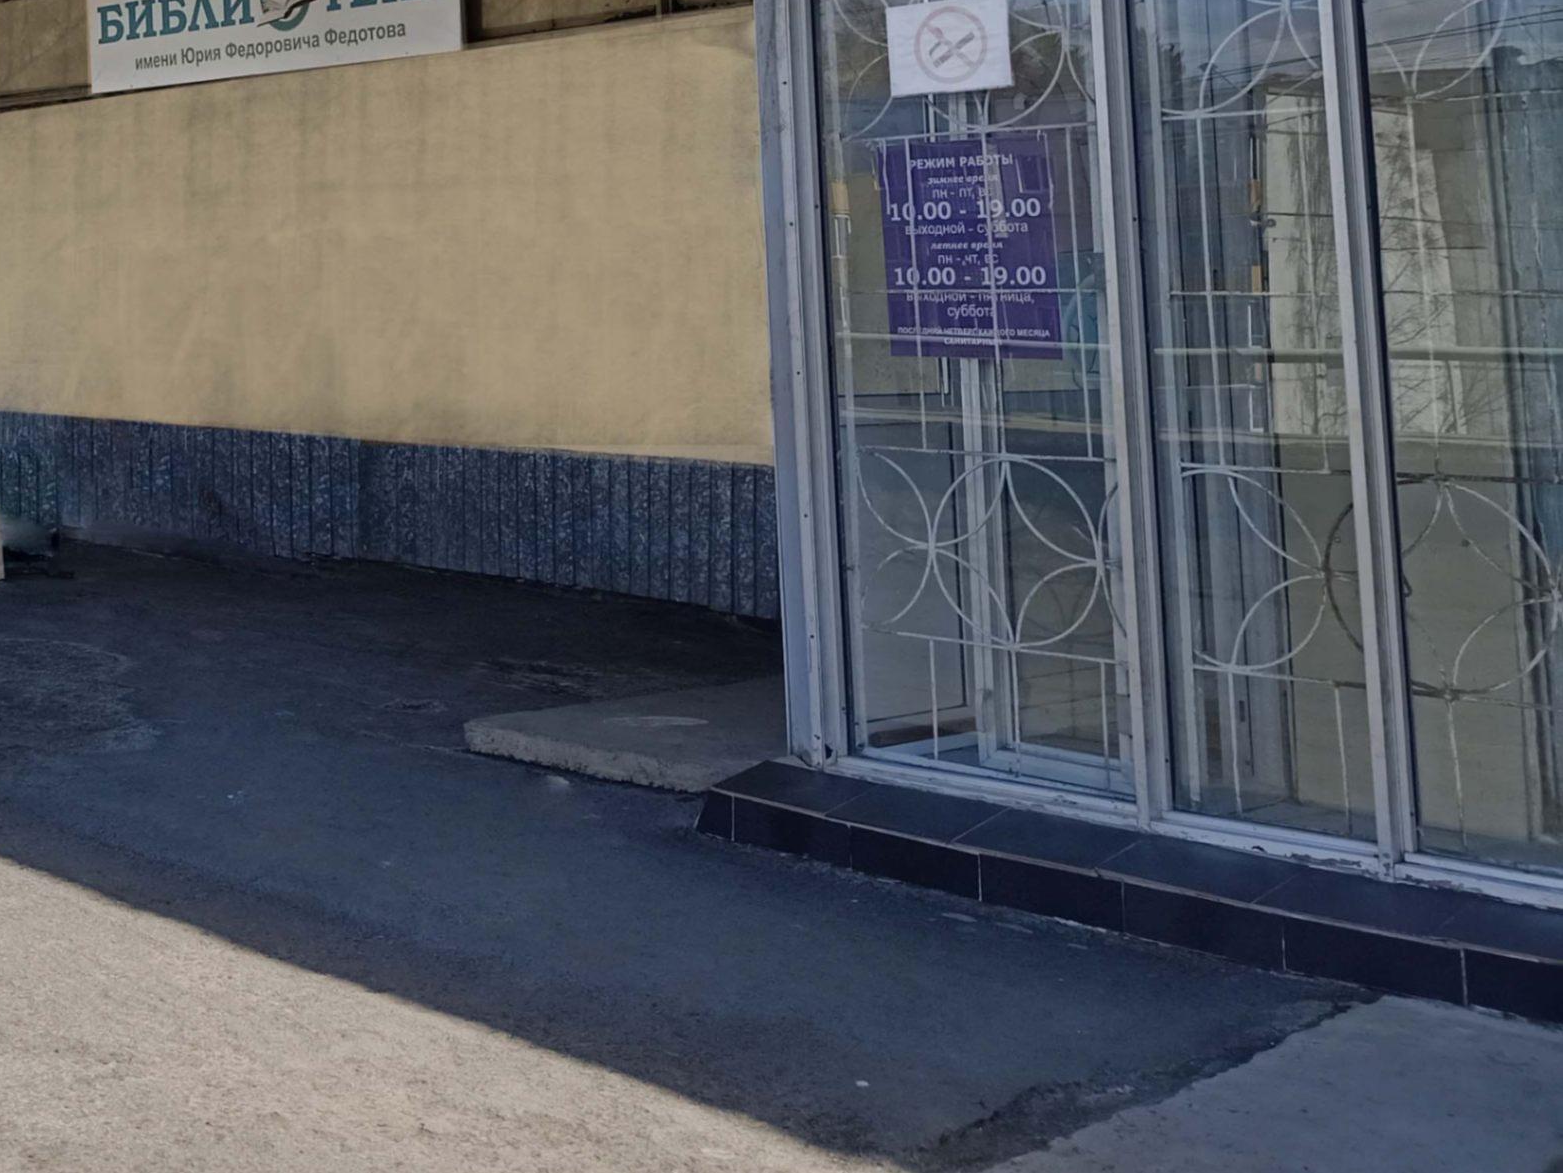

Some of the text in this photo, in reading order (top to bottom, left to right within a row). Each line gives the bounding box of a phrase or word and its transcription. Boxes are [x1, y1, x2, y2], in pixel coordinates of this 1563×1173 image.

[135, 22, 407, 71] имени Юрия Федоровича Федотова
[909, 153, 1013, 169] РЕЖИМ РАБОТЫ
[927, 176, 964, 185] зимнее
[890, 201, 952, 221] 10.00
[976, 198, 1041, 219] 19.00
[905, 221, 965, 236] выходной
[894, 267, 955, 285] 10.00
[980, 266, 1046, 285] 19.00
[979, 291, 1034, 304] пяница,
[1017, 328, 1051, 337] МЕСЯЦА
